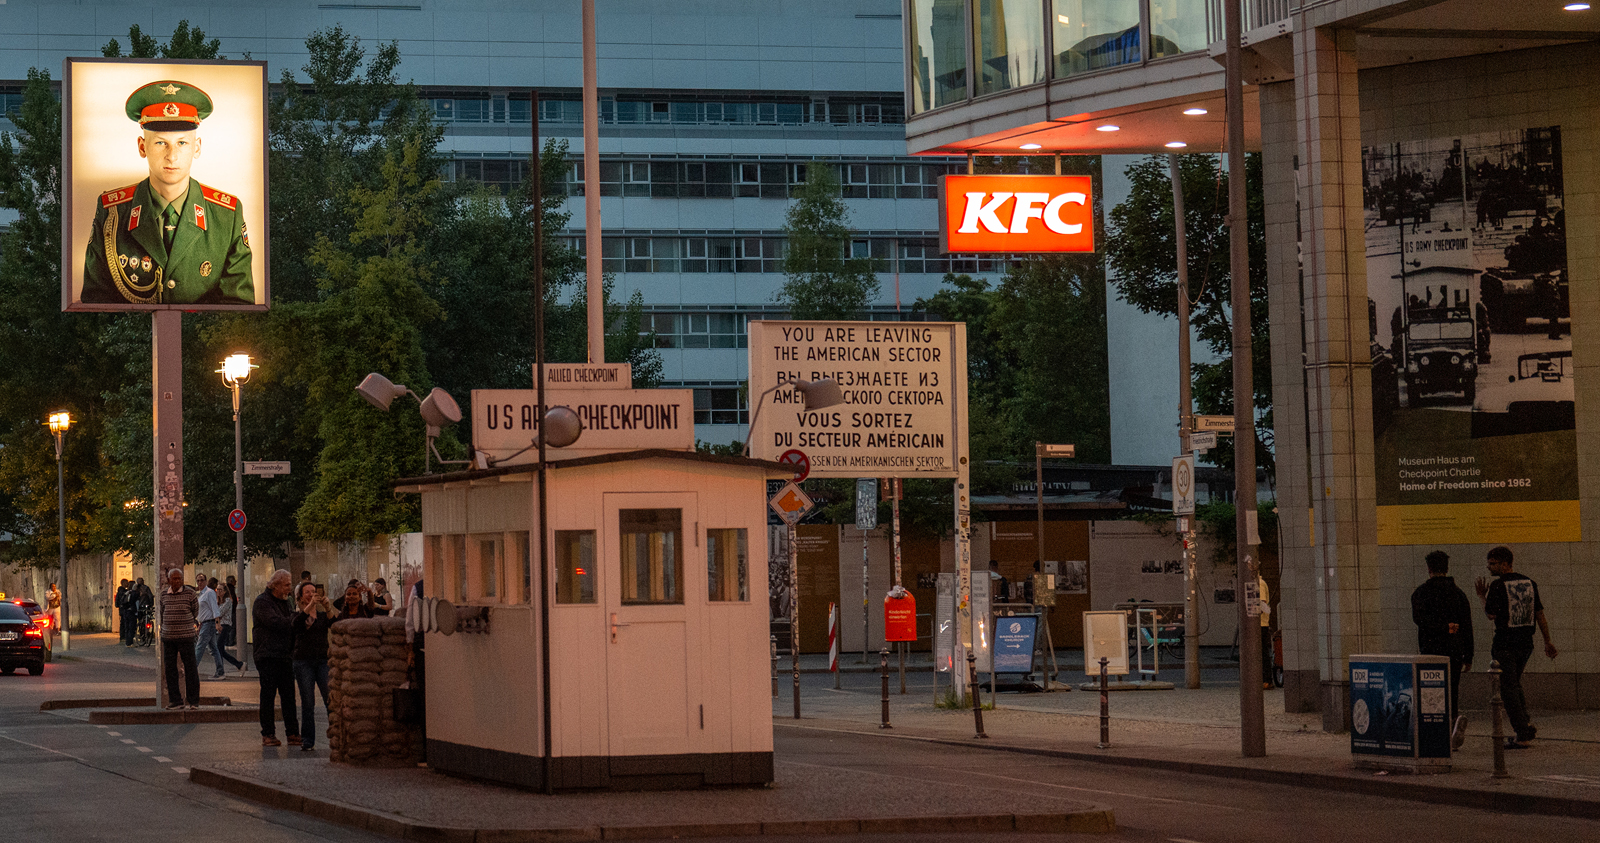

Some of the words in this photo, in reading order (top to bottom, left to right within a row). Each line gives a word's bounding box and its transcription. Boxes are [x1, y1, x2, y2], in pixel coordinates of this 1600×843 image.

[957, 192, 1086, 234] KFC
[1416, 240, 1432, 252] ARMY
[1434, 238, 1468, 252] CHECKPOINT
[782, 327, 814, 342] YOU
[824, 328, 856, 342] ARE
[866, 328, 932, 343] LEAVING
[774, 346, 798, 361] THE
[807, 347, 880, 361] AMERICAN
[889, 347, 941, 362] SECTOR
[548, 368, 572, 382] ALLIED
[574, 368, 619, 382] CHECKPOINT
[920, 372, 939, 387] ИЗ
[888, 391, 944, 405] СЕКТОРА
[578, 404, 680, 429] CHECKPOINT
[797, 413, 841, 428] VOUS
[852, 413, 913, 428] SORTEZ
[775, 432, 792, 447] DU
[799, 432, 861, 448] SECTEUR
[867, 431, 944, 448] AMÉRICAIN
[832, 456, 847, 466] DEN
[850, 456, 914, 467] AMERIKANISCHEN
[917, 456, 944, 467] SEKTOR
[1398, 458, 1435, 466] Museum
[1437, 456, 1459, 464] Haus
[1179, 470, 1187, 487] 30
[1399, 469, 1448, 479] Checkpoint
[1449, 467, 1481, 476] Charlie
[1400, 483, 1426, 491] Home
[1427, 481, 1437, 490] of
[1438, 480, 1479, 490] Freedom
[1481, 479, 1506, 488] since
[1508, 478, 1531, 487] 1962
[1354, 671, 1366, 680] DDR
